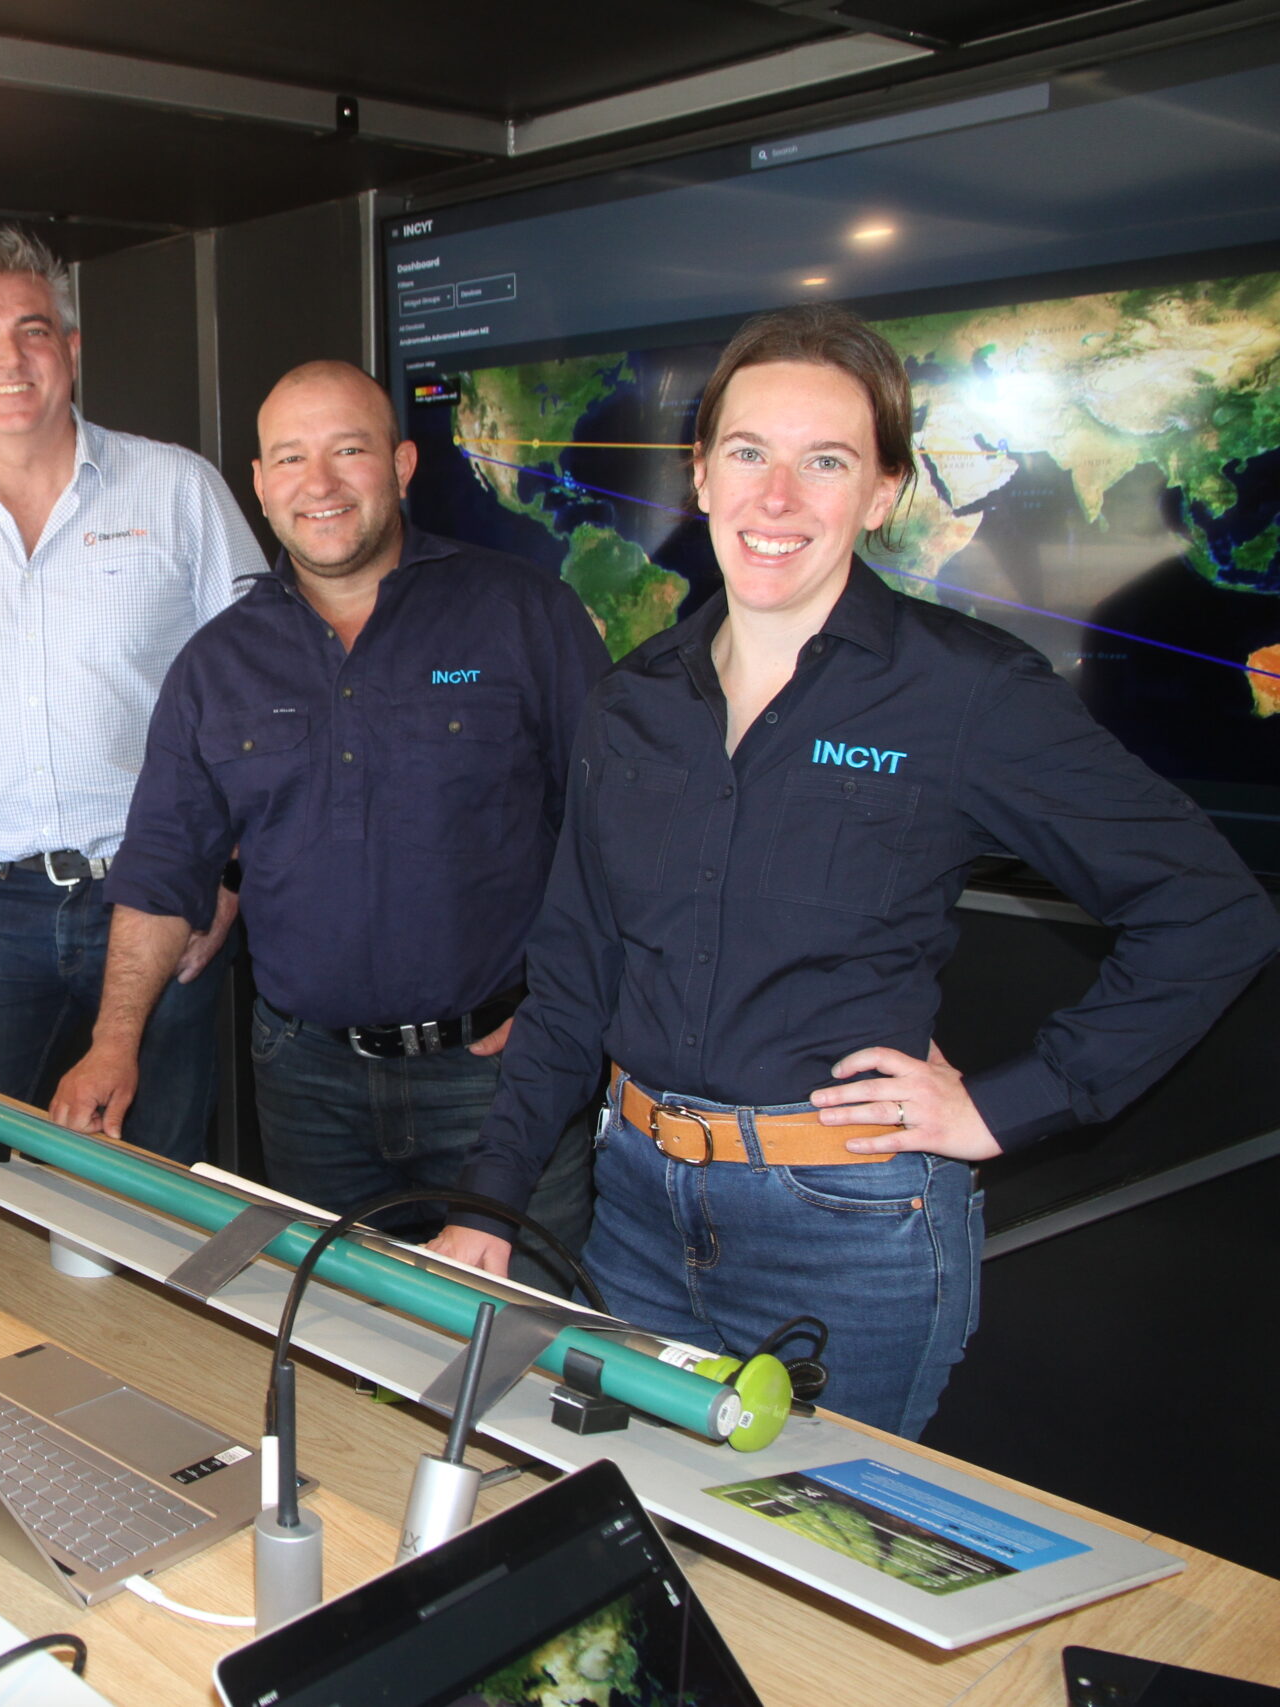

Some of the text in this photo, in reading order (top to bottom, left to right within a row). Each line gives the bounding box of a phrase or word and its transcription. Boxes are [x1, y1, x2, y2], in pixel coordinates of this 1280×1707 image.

[403, 219, 433, 238] INCYT
[397, 257, 440, 274] Dashboard
[432, 669, 480, 684] INCYT
[812, 739, 908, 774] INCYT
